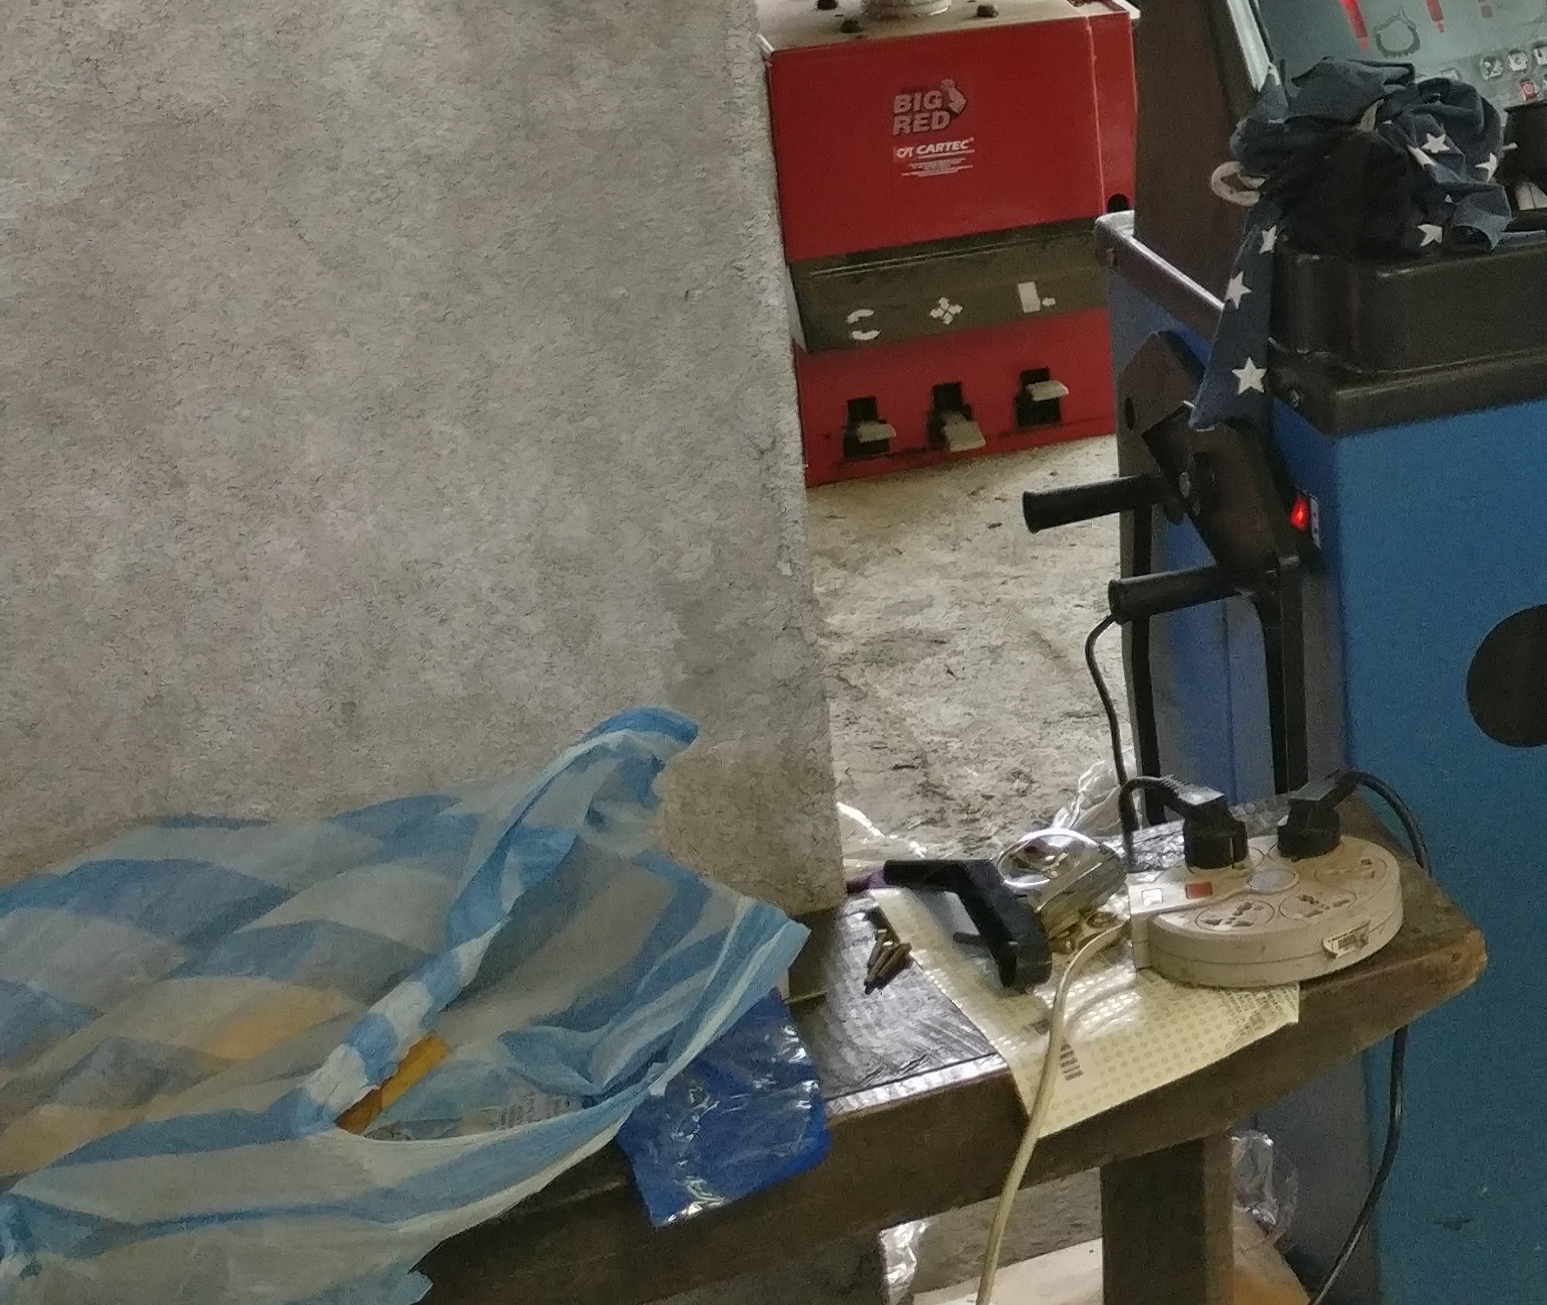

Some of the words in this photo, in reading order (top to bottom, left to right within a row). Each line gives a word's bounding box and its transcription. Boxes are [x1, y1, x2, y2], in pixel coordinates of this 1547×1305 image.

[893, 90, 943, 114] BIG
[893, 110, 951, 135] RED
[917, 139, 969, 155] CARTEC
